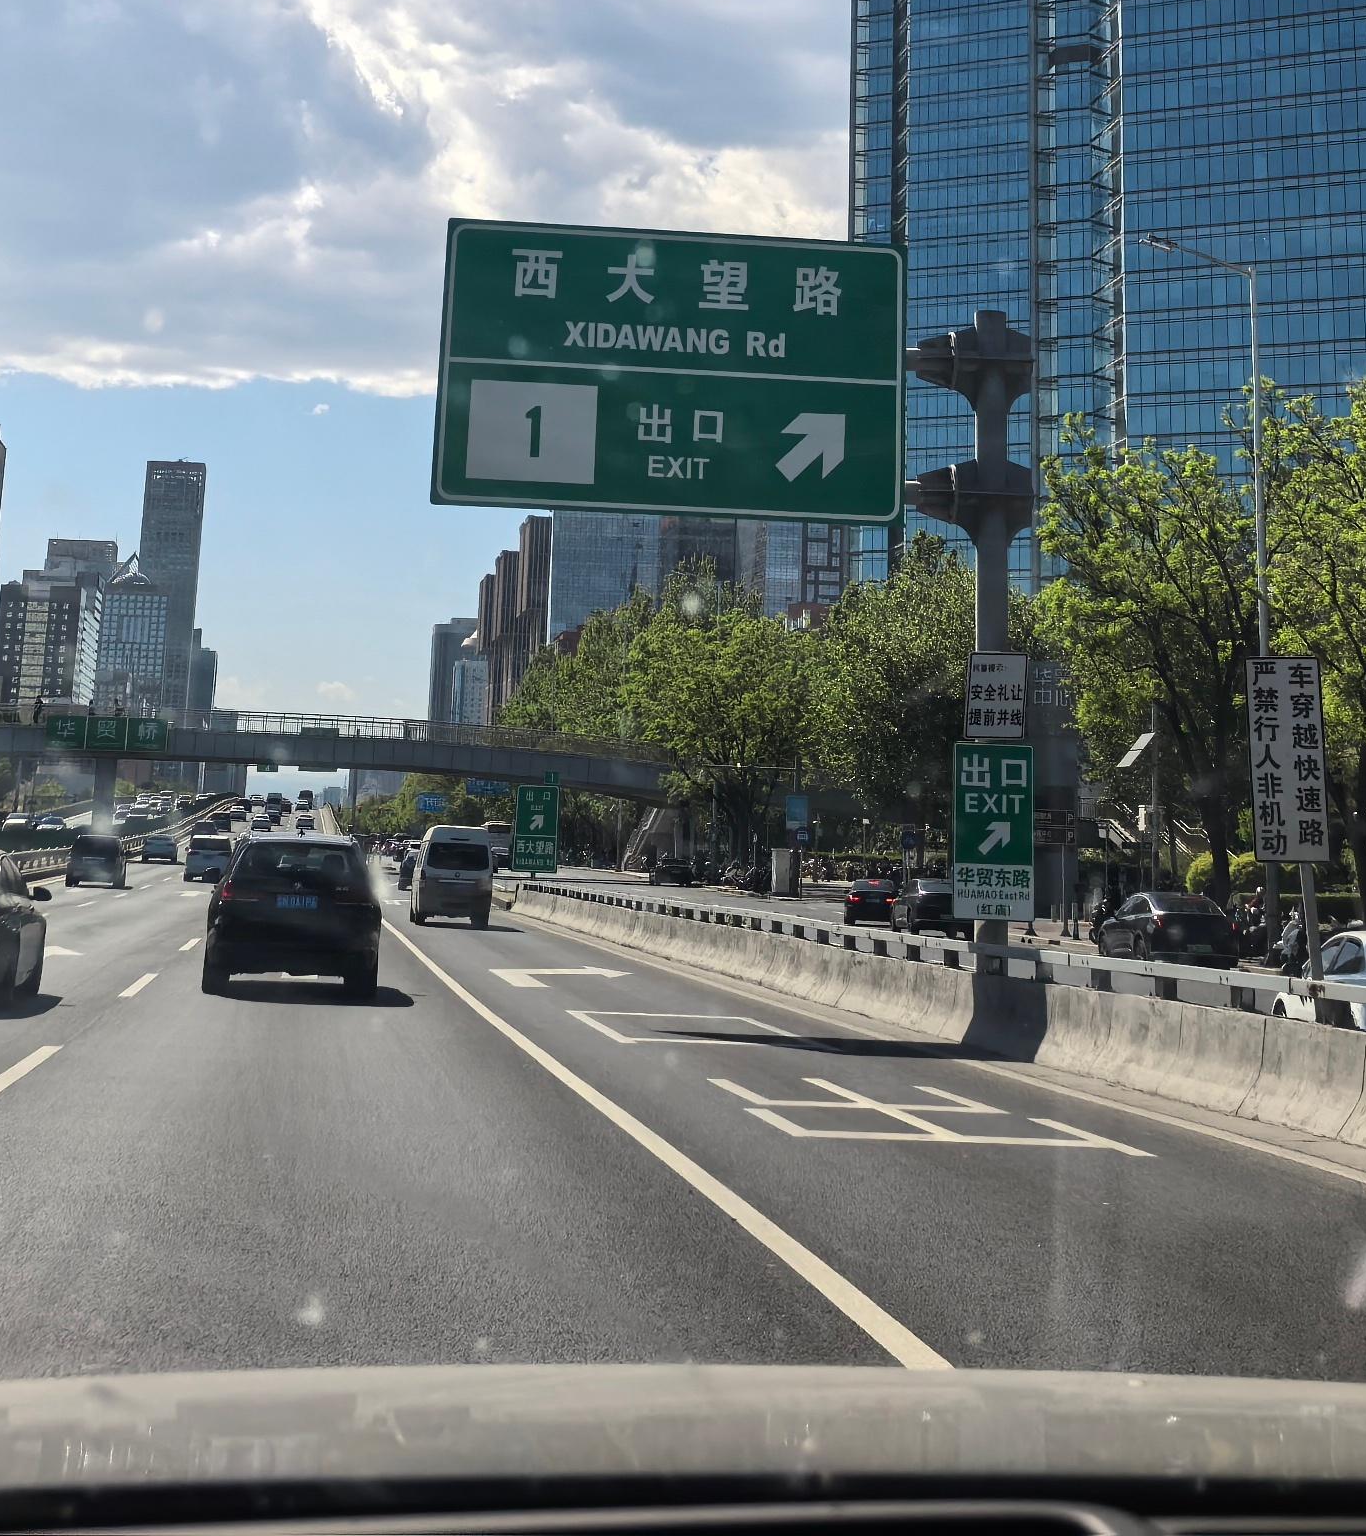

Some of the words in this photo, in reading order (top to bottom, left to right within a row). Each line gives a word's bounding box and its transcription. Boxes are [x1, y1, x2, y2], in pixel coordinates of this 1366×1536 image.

[510, 247, 843, 316] 西大望路
[563, 320, 731, 356] XIDAWANG
[746, 331, 787, 359] Rd
[523, 404, 541, 458] 1
[637, 404, 725, 444] 出口
[647, 455, 711, 481] EXIT
[970, 683, 1024, 702] 安全礼让
[968, 707, 1023, 727] 提前并线
[961, 753, 1028, 789] 出口
[1251, 660, 1288, 856] 严禁行人非机动
[1288, 663, 1325, 848] 车穿越快速路
[964, 792, 1026, 815] EXIT
[956, 866, 1031, 889] 华贸东路
[957, 889, 997, 901] HUAMAO
